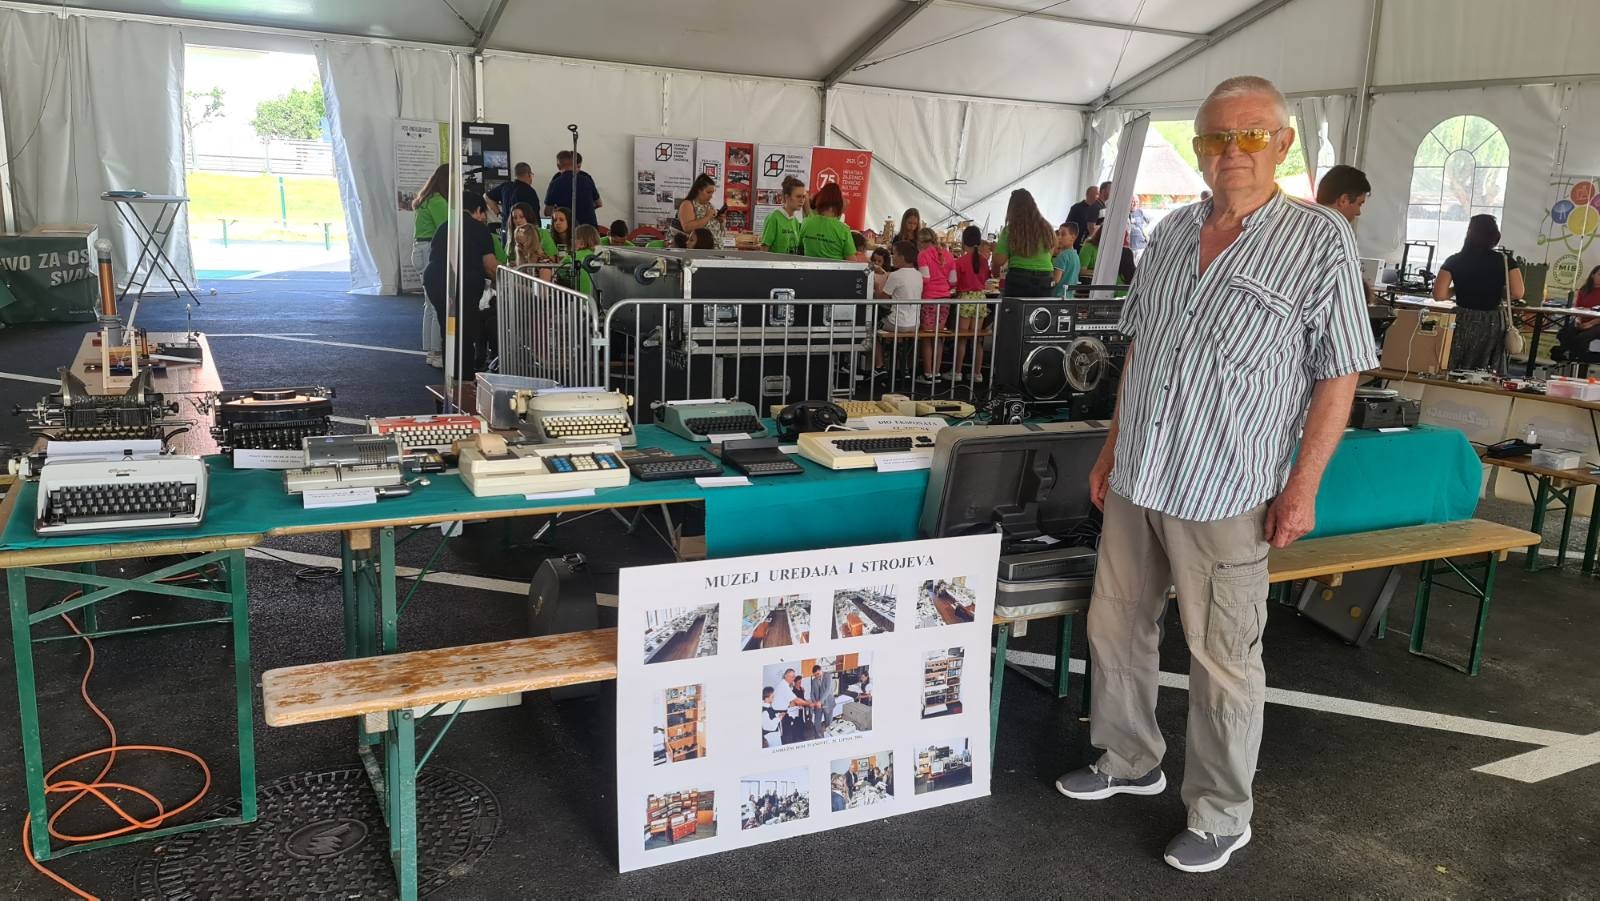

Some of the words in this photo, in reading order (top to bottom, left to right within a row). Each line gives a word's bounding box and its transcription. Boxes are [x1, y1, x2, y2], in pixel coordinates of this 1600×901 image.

[820, 174, 836, 188] 75
[38, 252, 60, 269] ZA
[705, 571, 759, 590] MUZEJ
[769, 564, 839, 582] UREĐAJA
[848, 562, 854, 574] I
[861, 554, 935, 573] STROJEVA
